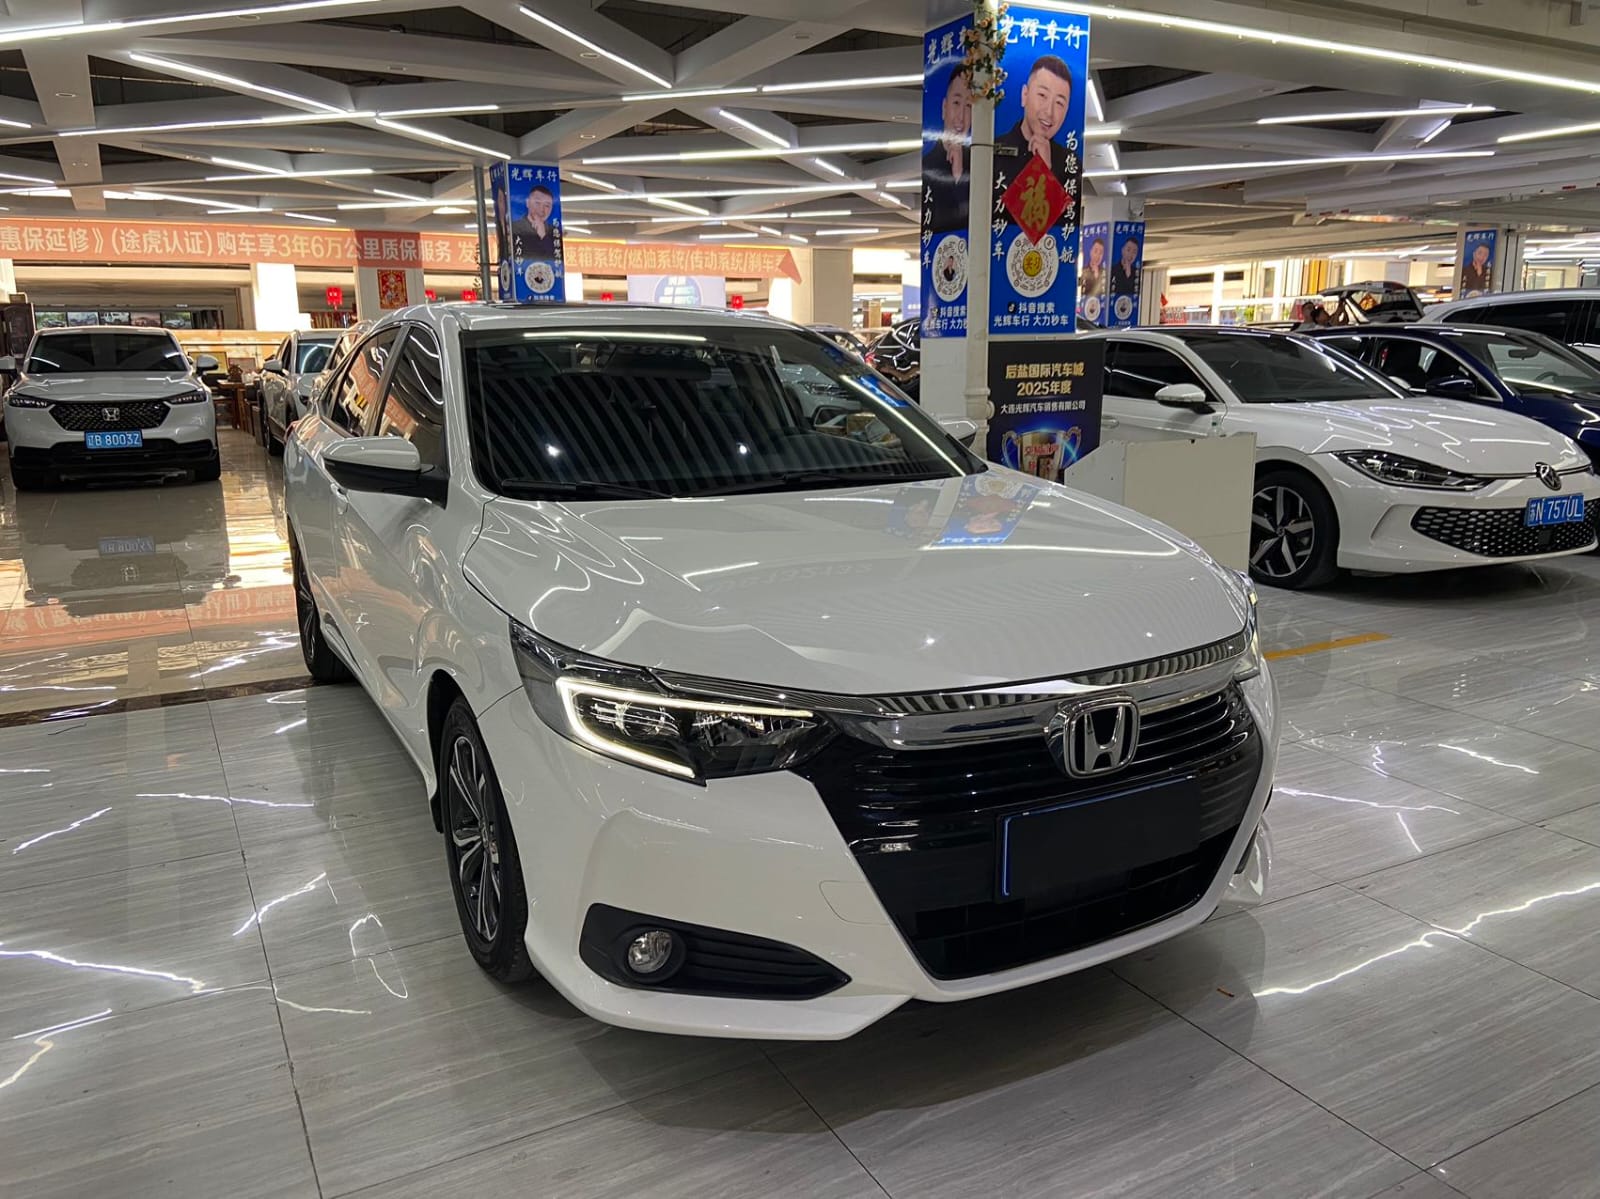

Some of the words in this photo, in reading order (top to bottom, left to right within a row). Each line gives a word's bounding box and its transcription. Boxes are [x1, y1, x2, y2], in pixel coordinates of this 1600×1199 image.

[1018, 302, 1055, 314] 抖音搜索
[993, 315, 1030, 326] 光辉车行
[1017, 380, 1072, 396] 2025年度
